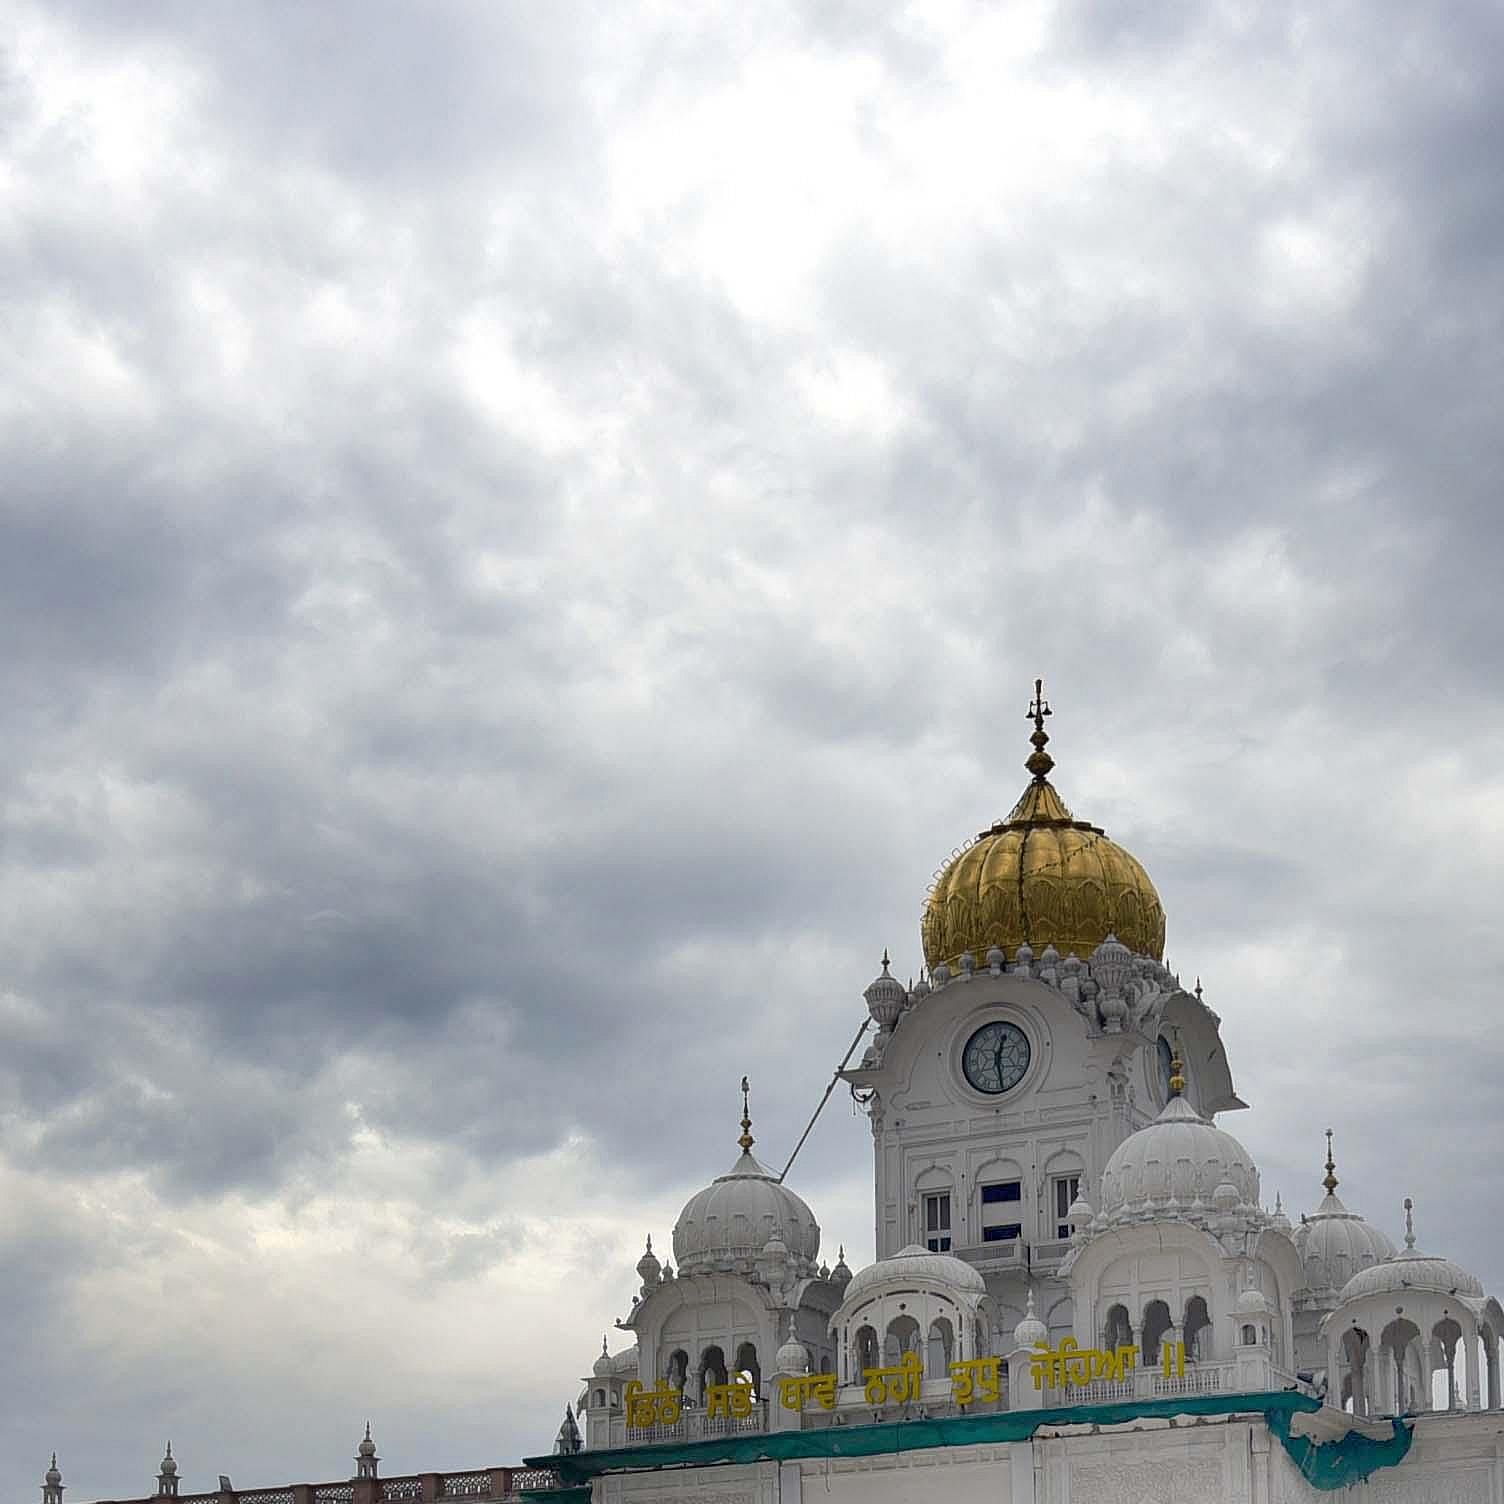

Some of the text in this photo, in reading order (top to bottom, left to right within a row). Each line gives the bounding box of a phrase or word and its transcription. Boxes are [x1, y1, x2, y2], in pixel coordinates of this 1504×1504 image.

[623, 1378, 682, 1428] ਡਿਠੇ
[704, 1371, 753, 1418] ਸਭੇ
[863, 1351, 924, 1404] ਨਹੀ
[1029, 1336, 1140, 1390] ਜੇਹਿਆ
